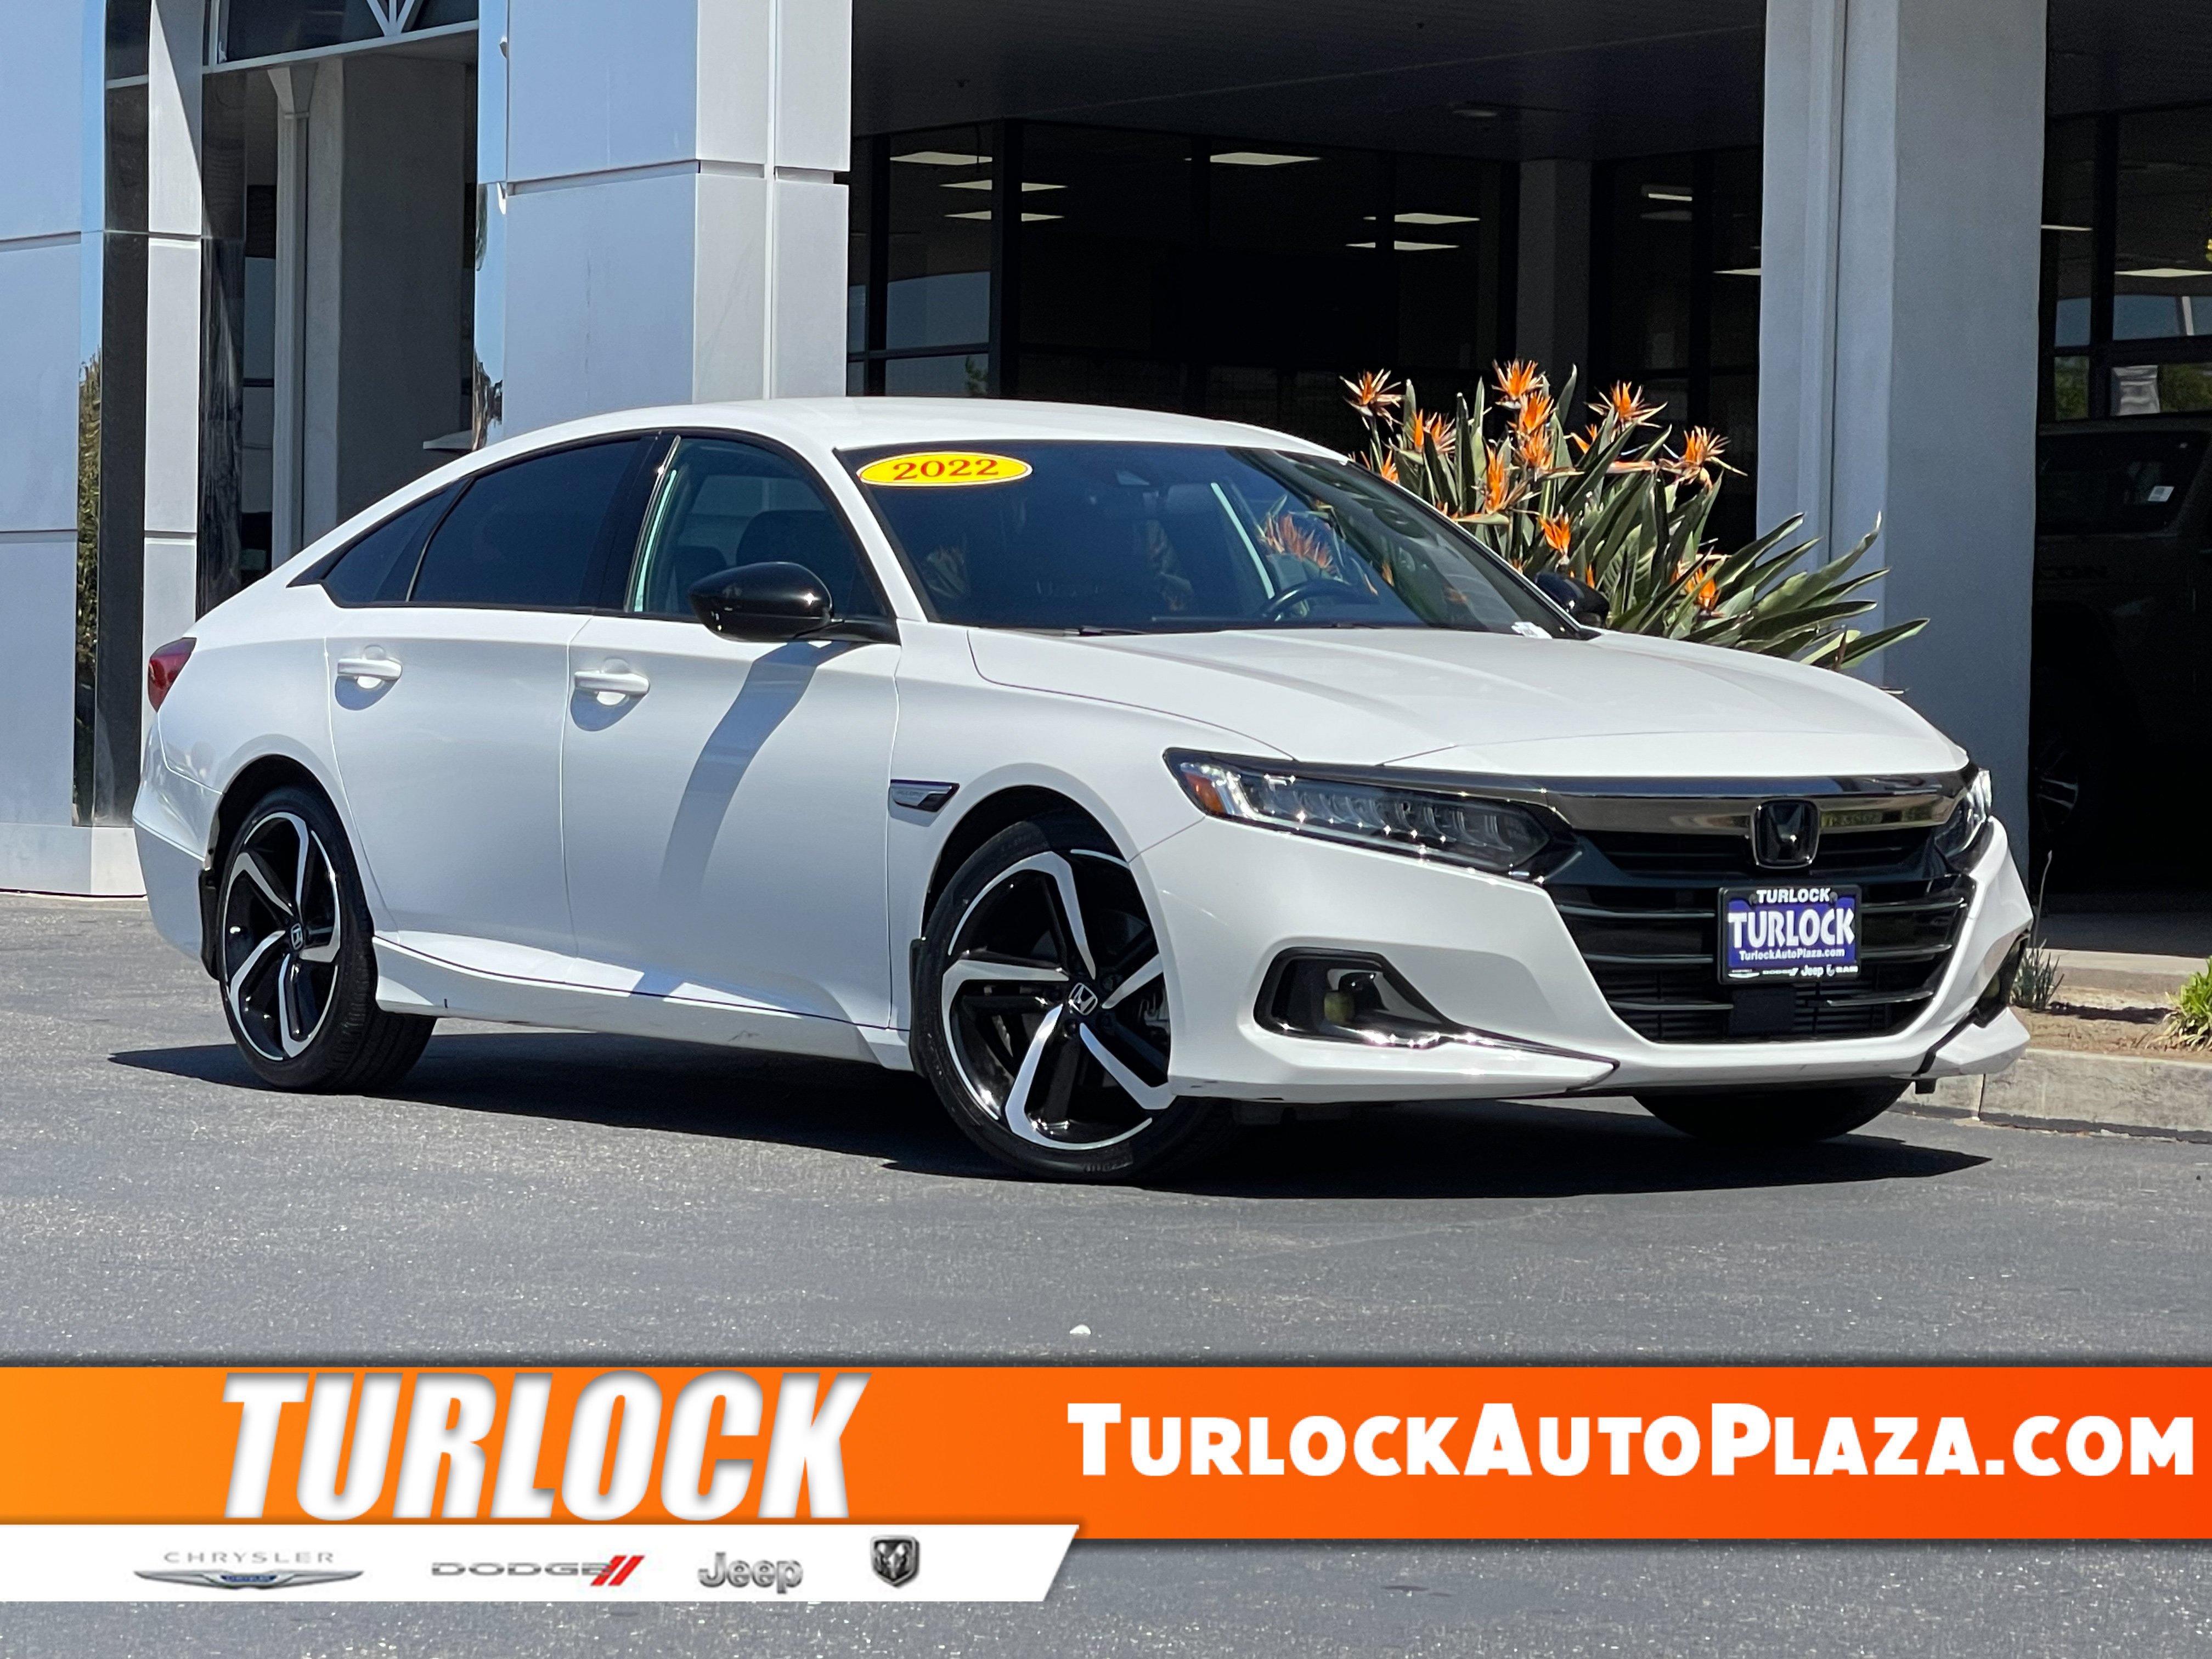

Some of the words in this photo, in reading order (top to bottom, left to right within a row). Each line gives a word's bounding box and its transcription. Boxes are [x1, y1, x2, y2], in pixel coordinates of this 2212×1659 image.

[893, 459, 999, 481] 2022
[1756, 888, 1831, 904] TURLOCK
[1728, 908, 1855, 949] TURLOCK
[1739, 948, 1845, 961] TurlockAutoPlaza.com
[1801, 964, 1824, 977] Jeep
